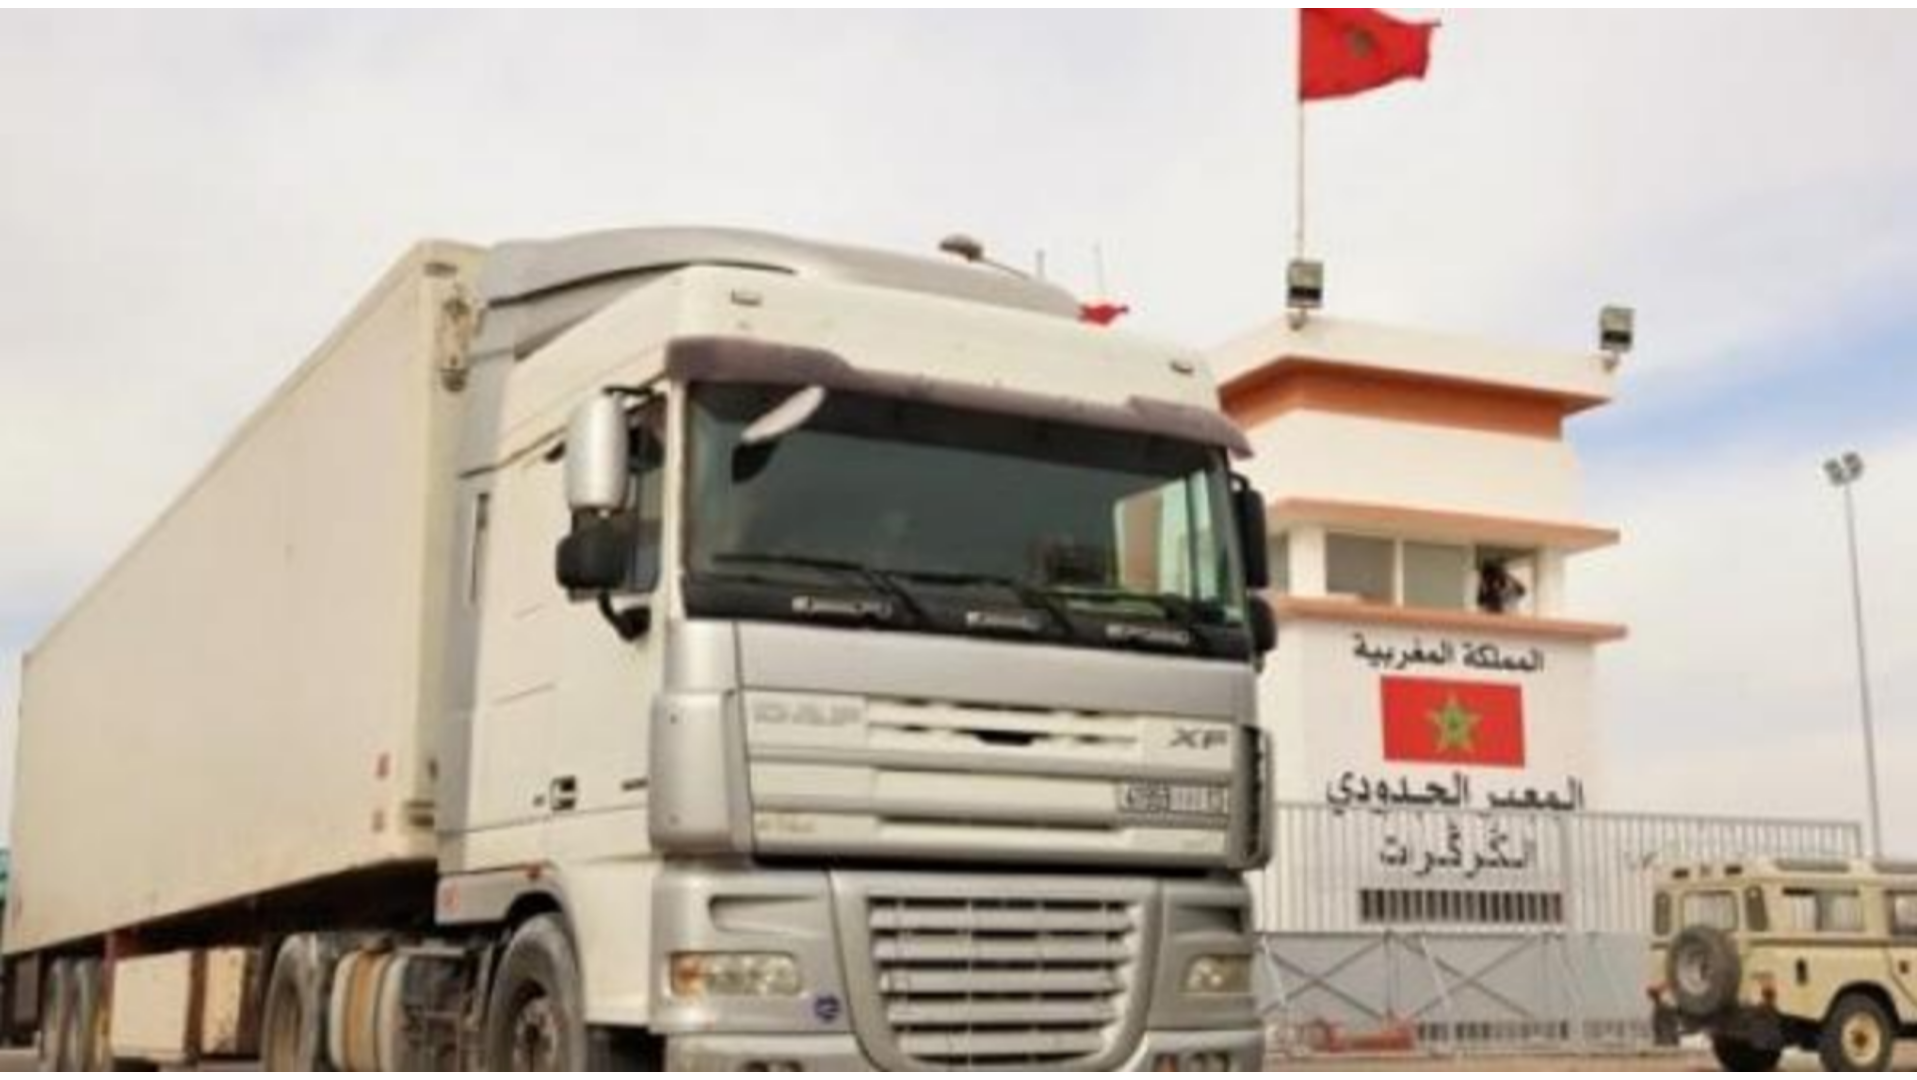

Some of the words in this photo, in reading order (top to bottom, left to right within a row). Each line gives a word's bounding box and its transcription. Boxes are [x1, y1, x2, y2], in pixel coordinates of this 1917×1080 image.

[1353, 632, 1455, 669] المغربية
[1462, 641, 1544, 673] المملكة
[1168, 727, 1228, 750] XF
[1326, 770, 1469, 815] الحدودي
[1482, 775, 1586, 814] المعبر
